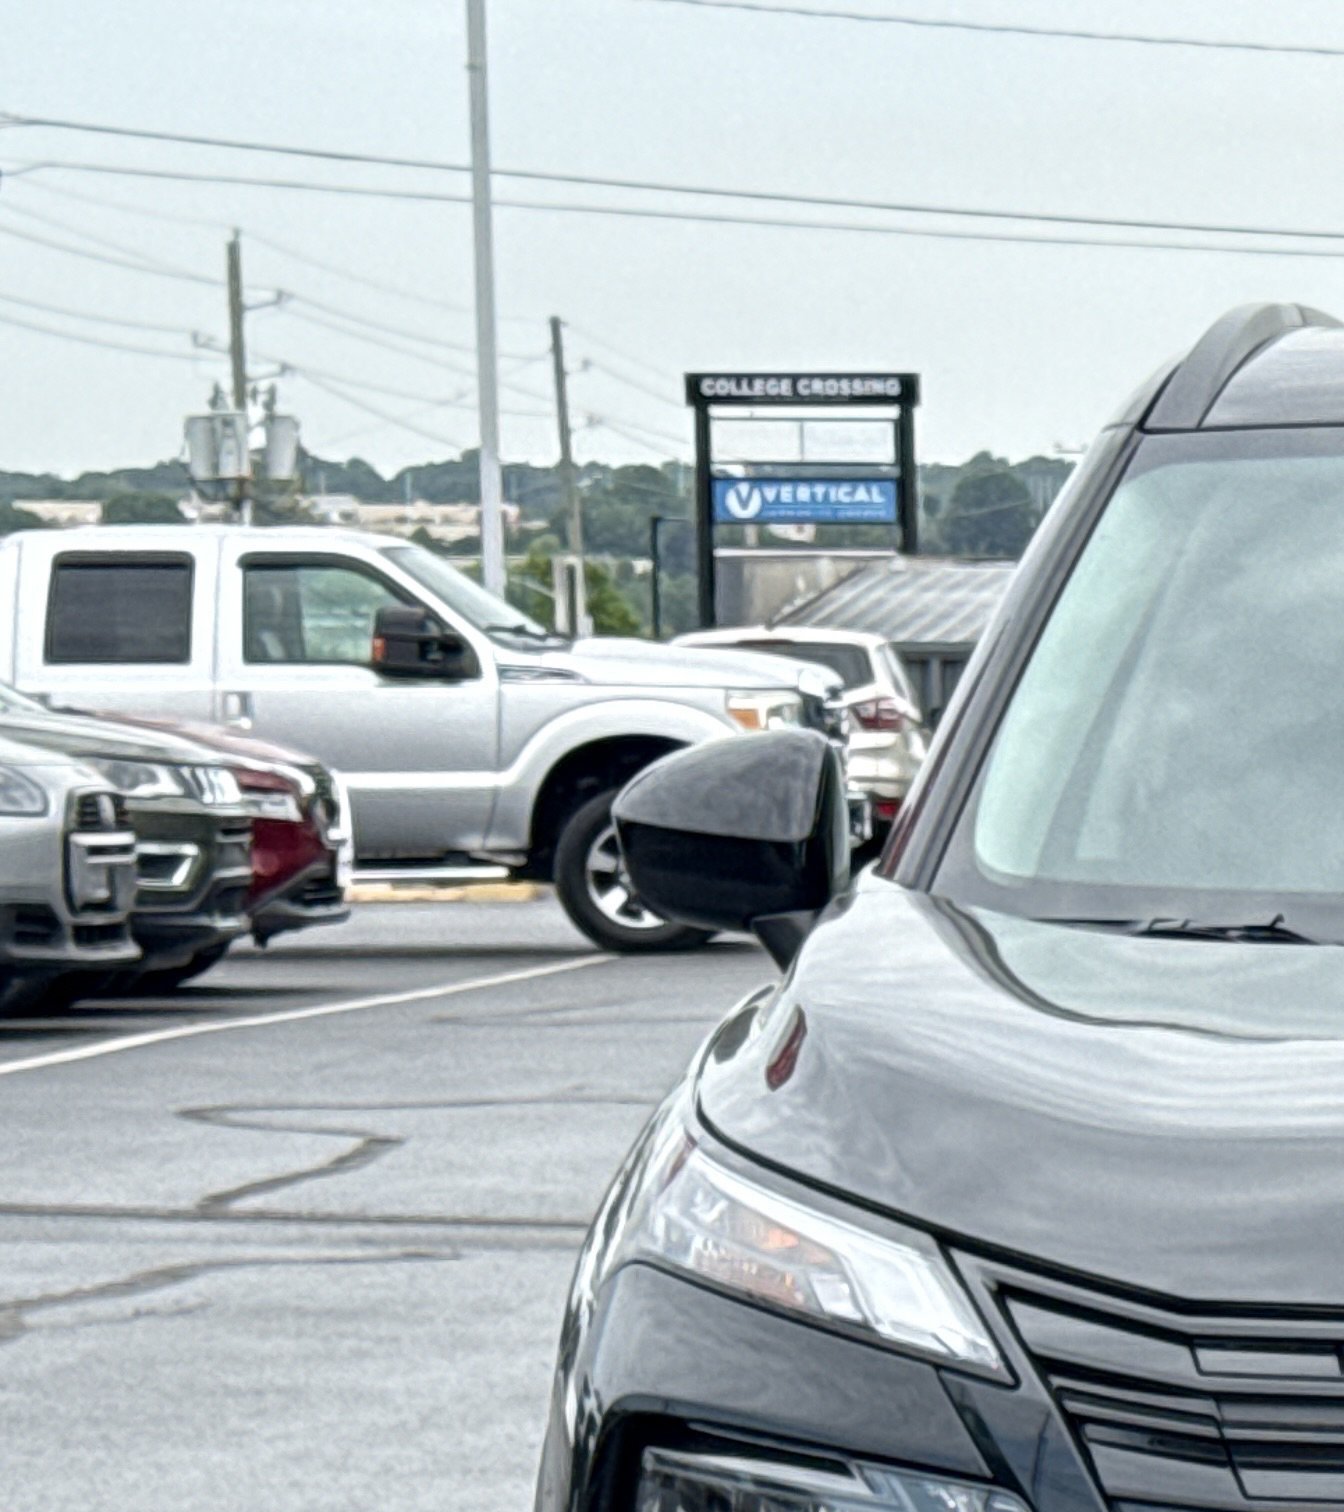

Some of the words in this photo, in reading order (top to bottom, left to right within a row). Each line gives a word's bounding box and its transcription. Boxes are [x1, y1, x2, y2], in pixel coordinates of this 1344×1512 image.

[701, 377, 793, 396] COLLEGE
[796, 377, 901, 396] CROSSING
[762, 485, 886, 504] VERTICAL
